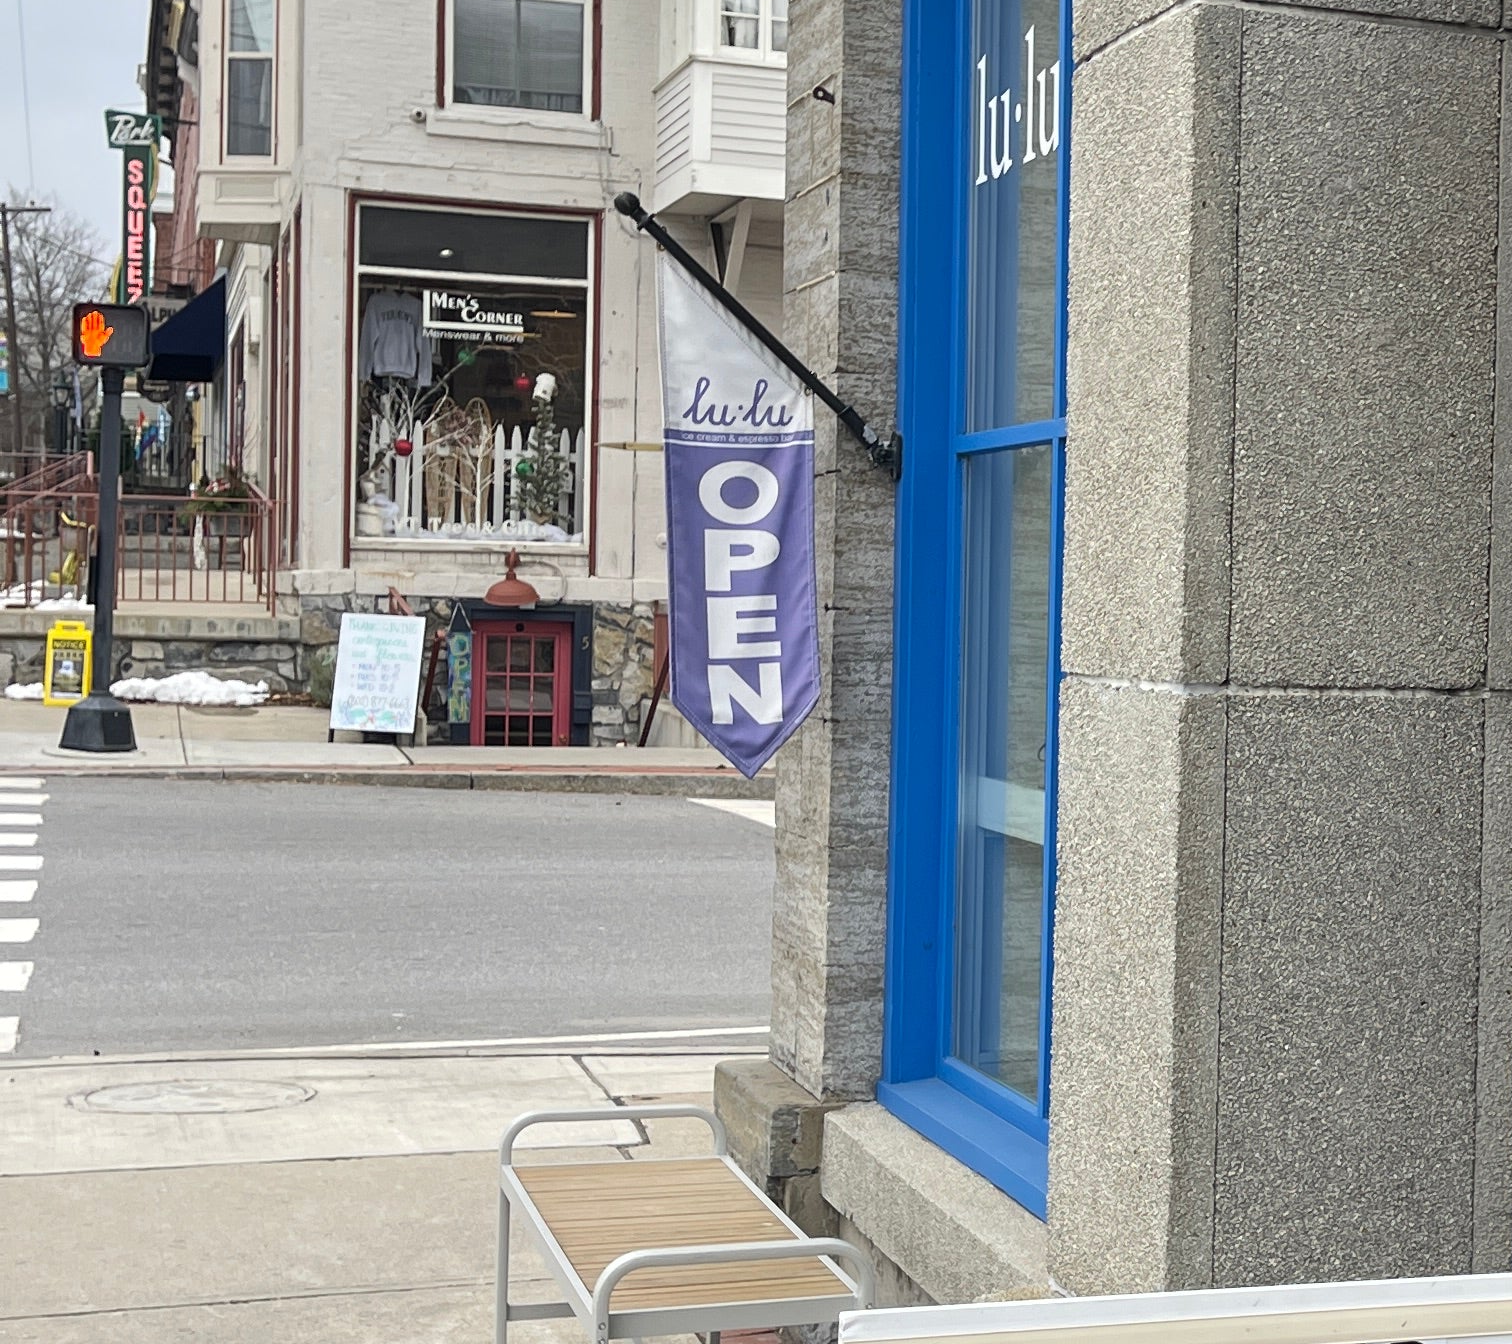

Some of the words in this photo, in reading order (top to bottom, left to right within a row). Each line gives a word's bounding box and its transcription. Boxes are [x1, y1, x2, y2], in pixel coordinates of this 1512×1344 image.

[108, 115, 156, 144] Park
[461, 306, 523, 324] CORNER
[423, 328, 480, 340] Menswear
[483, 331, 492, 342] &
[495, 333, 525, 343] more
[697, 433, 726, 442] cream
[728, 433, 736, 442] &
[738, 434, 779, 444] espresso
[780, 433, 795, 442] bar
[481, 520, 496, 535] &
[699, 460, 783, 724] OPEN
[581, 635, 590, 651] 5
[449, 634, 469, 721] OPEN
